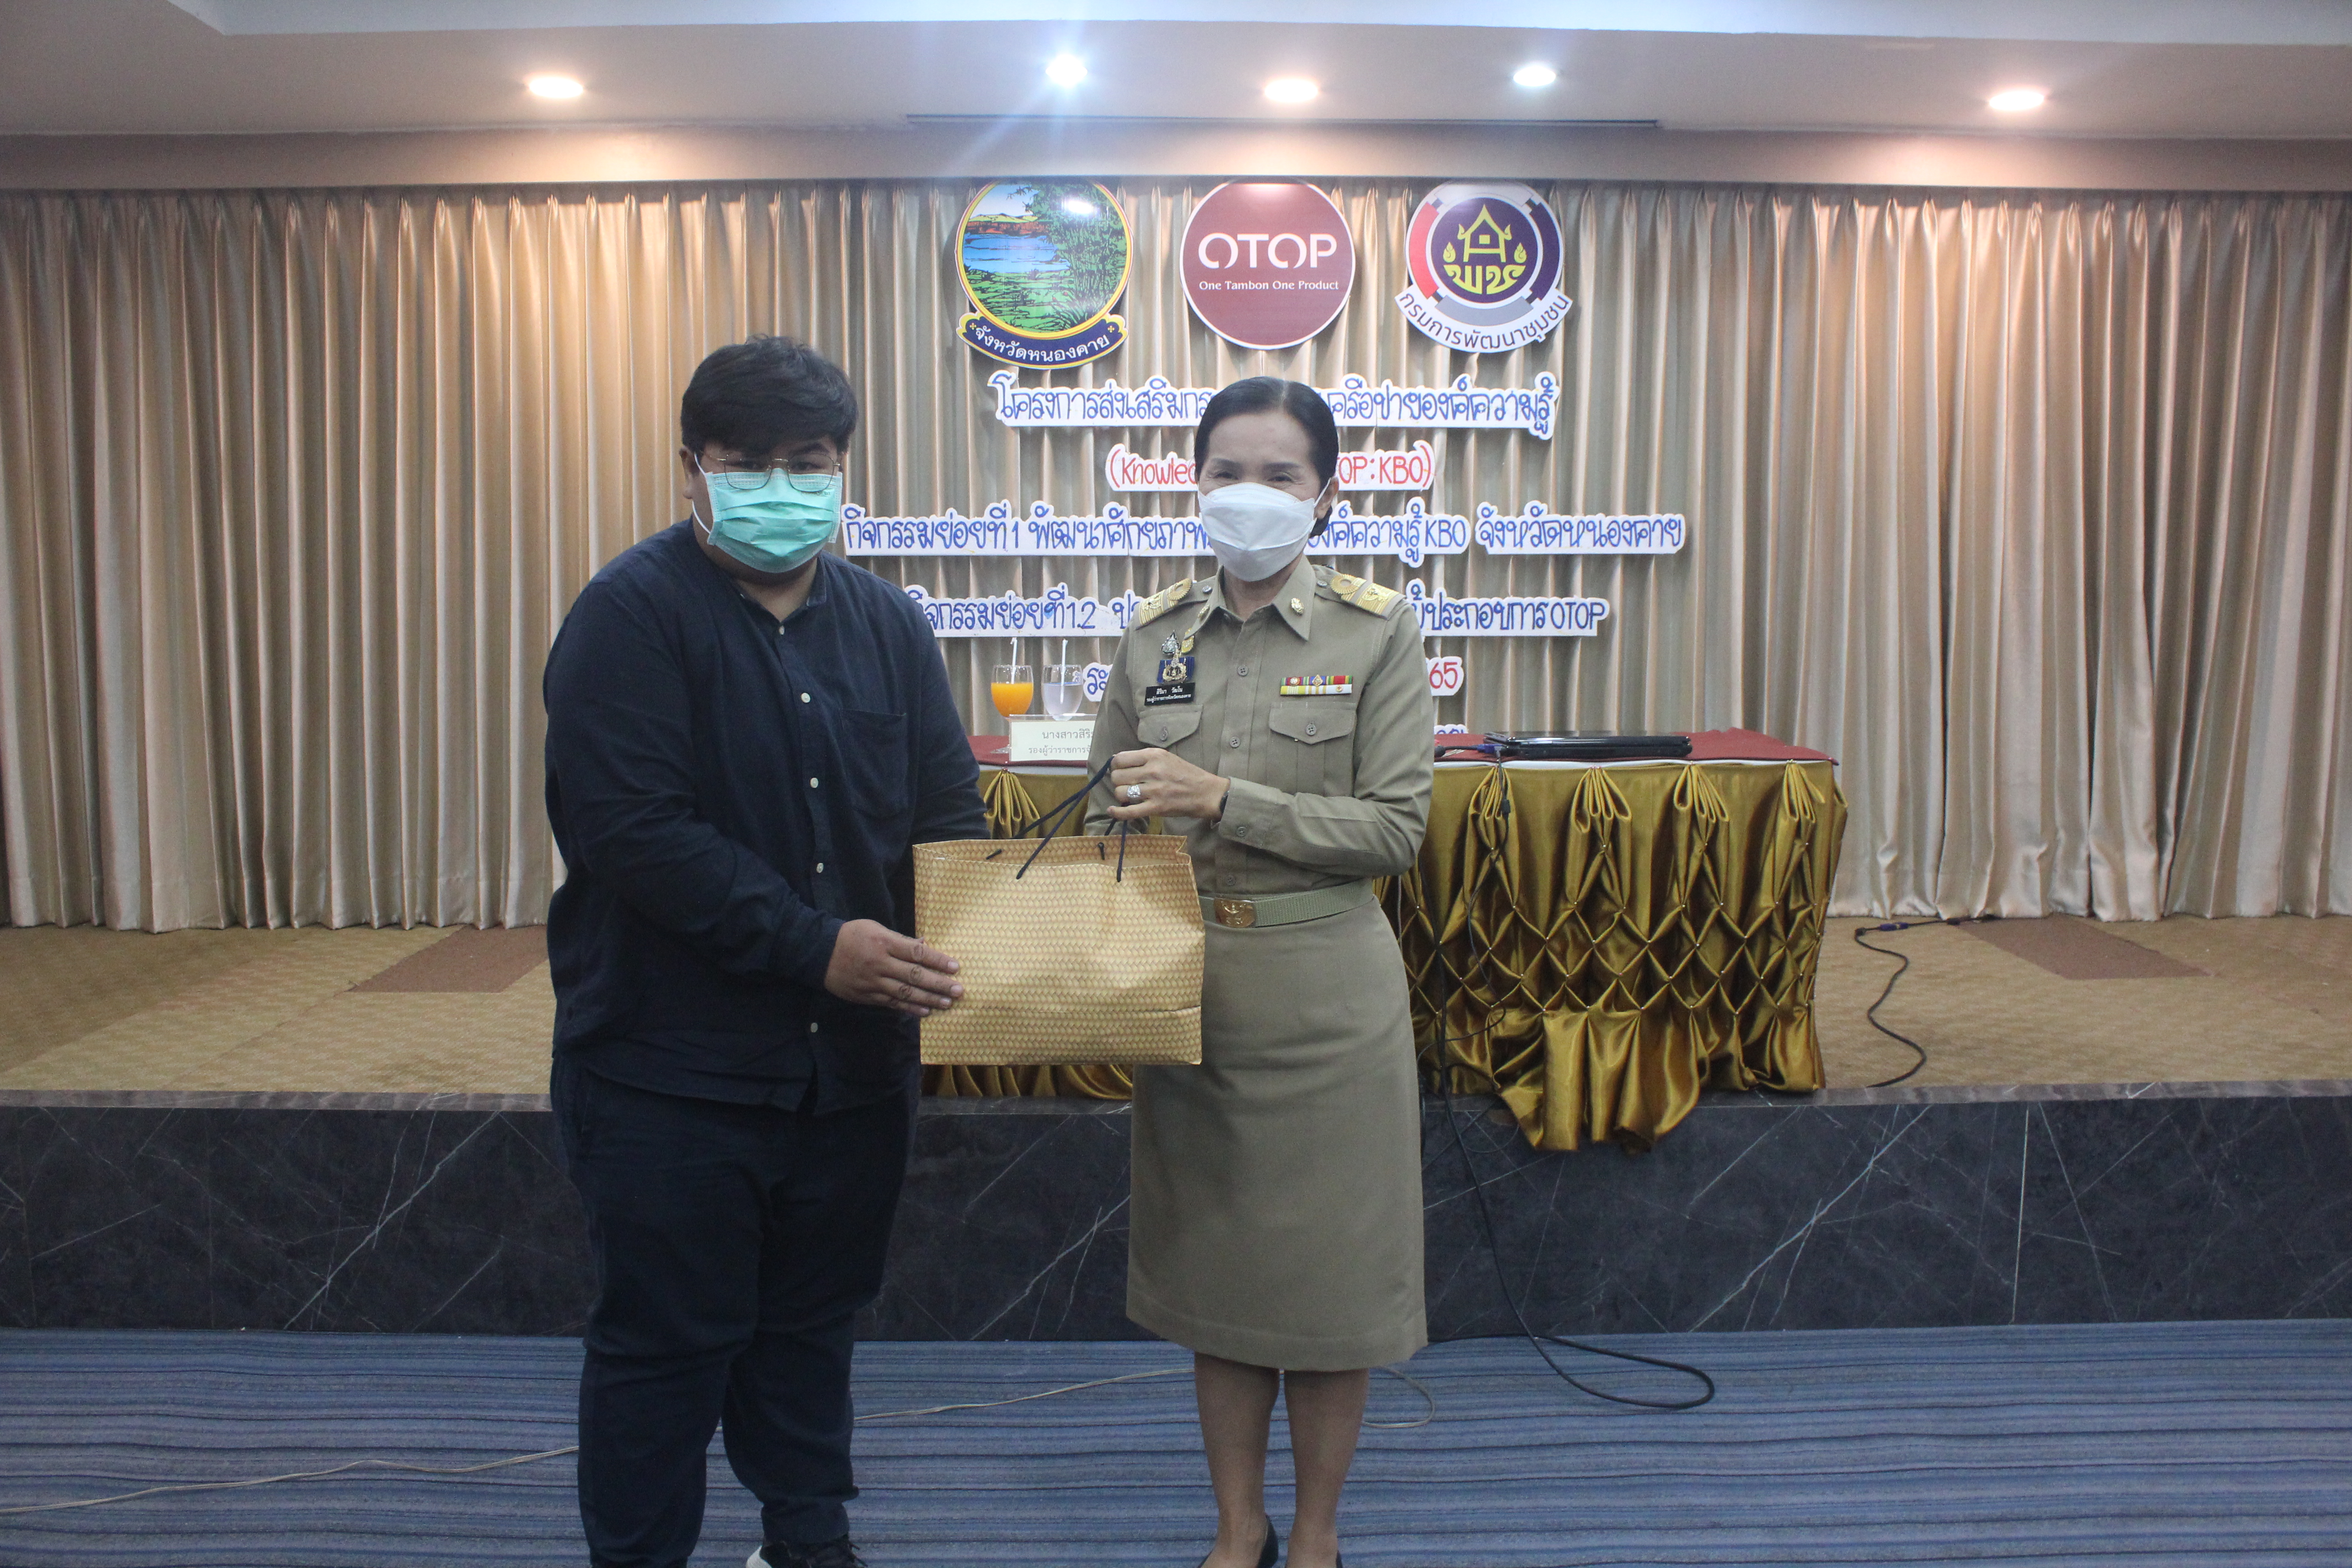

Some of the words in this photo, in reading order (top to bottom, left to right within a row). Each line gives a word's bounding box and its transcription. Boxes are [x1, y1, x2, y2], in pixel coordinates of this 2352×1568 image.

[1198, 232, 1337, 269] OTOP
[1199, 281, 1221, 290] One
[1225, 280, 1269, 290] Tambon
[1272, 281, 1295, 290] One
[1298, 281, 1339, 290] Product
[1399, 293, 1570, 349] กรมการพัฒนาชุมชน
[975, 325, 1110, 362] จังหวัดหนองคาย
[992, 373, 1215, 419] โครงการส่งเสริมกร
[1317, 376, 1555, 434] ครือข่ายองค์ความรู้
[1028, 505, 1212, 550] พัฒนาศักยภาพ
[1425, 519, 1466, 548] KBO
[1479, 505, 1681, 548] จังหวัดหนองคาย
[1550, 601, 1605, 630] OTOP
[1042, 728, 1095, 739] นางสาวสิริ
